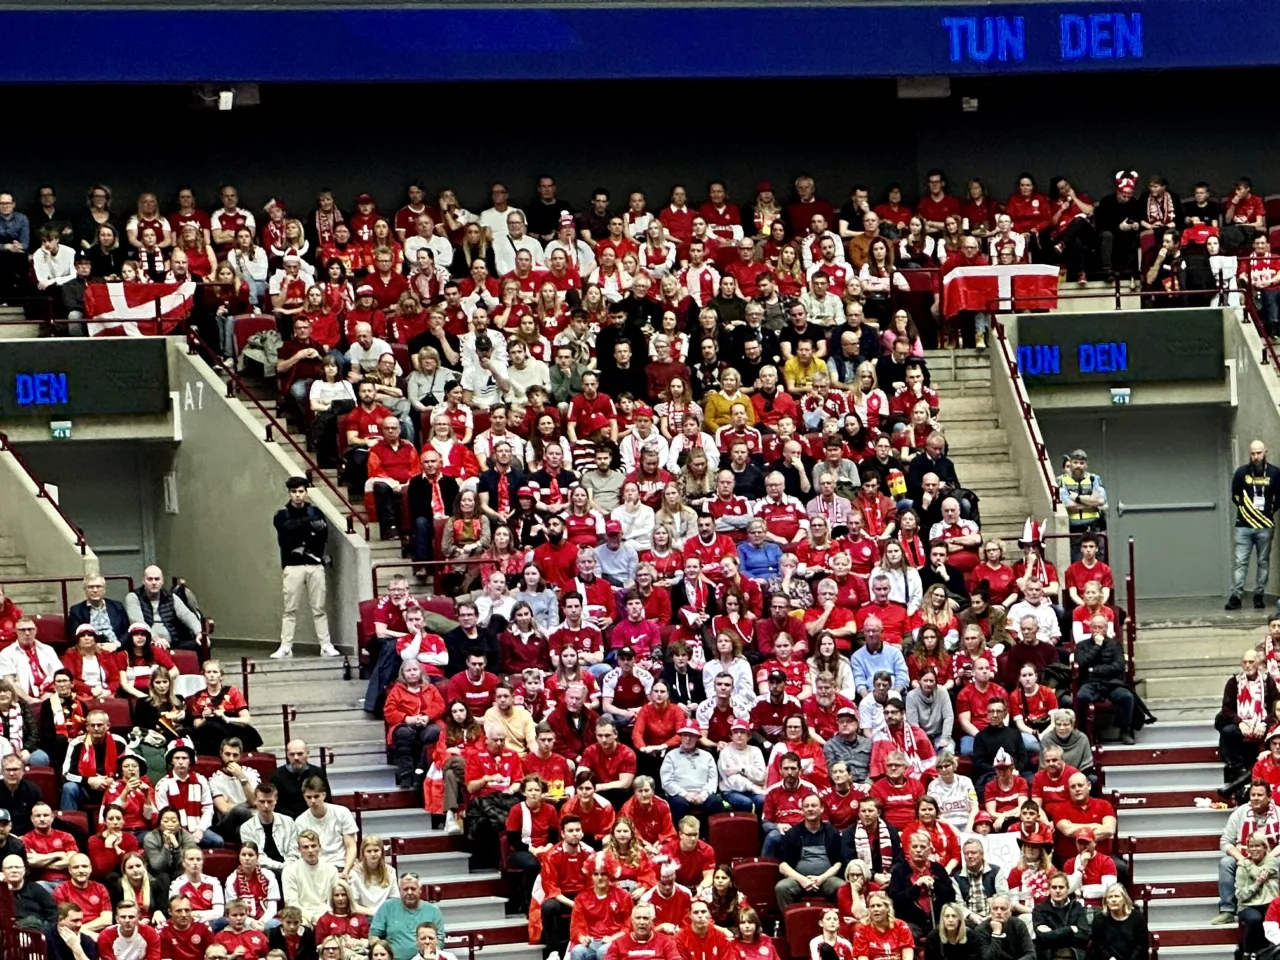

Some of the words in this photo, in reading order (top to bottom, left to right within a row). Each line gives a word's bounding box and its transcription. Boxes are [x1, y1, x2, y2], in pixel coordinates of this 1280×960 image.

[942, 16, 1025, 62] TUN
[1060, 13, 1144, 58] DEN
[1078, 342, 1128, 372] DEN
[15, 373, 68, 404] DEN
